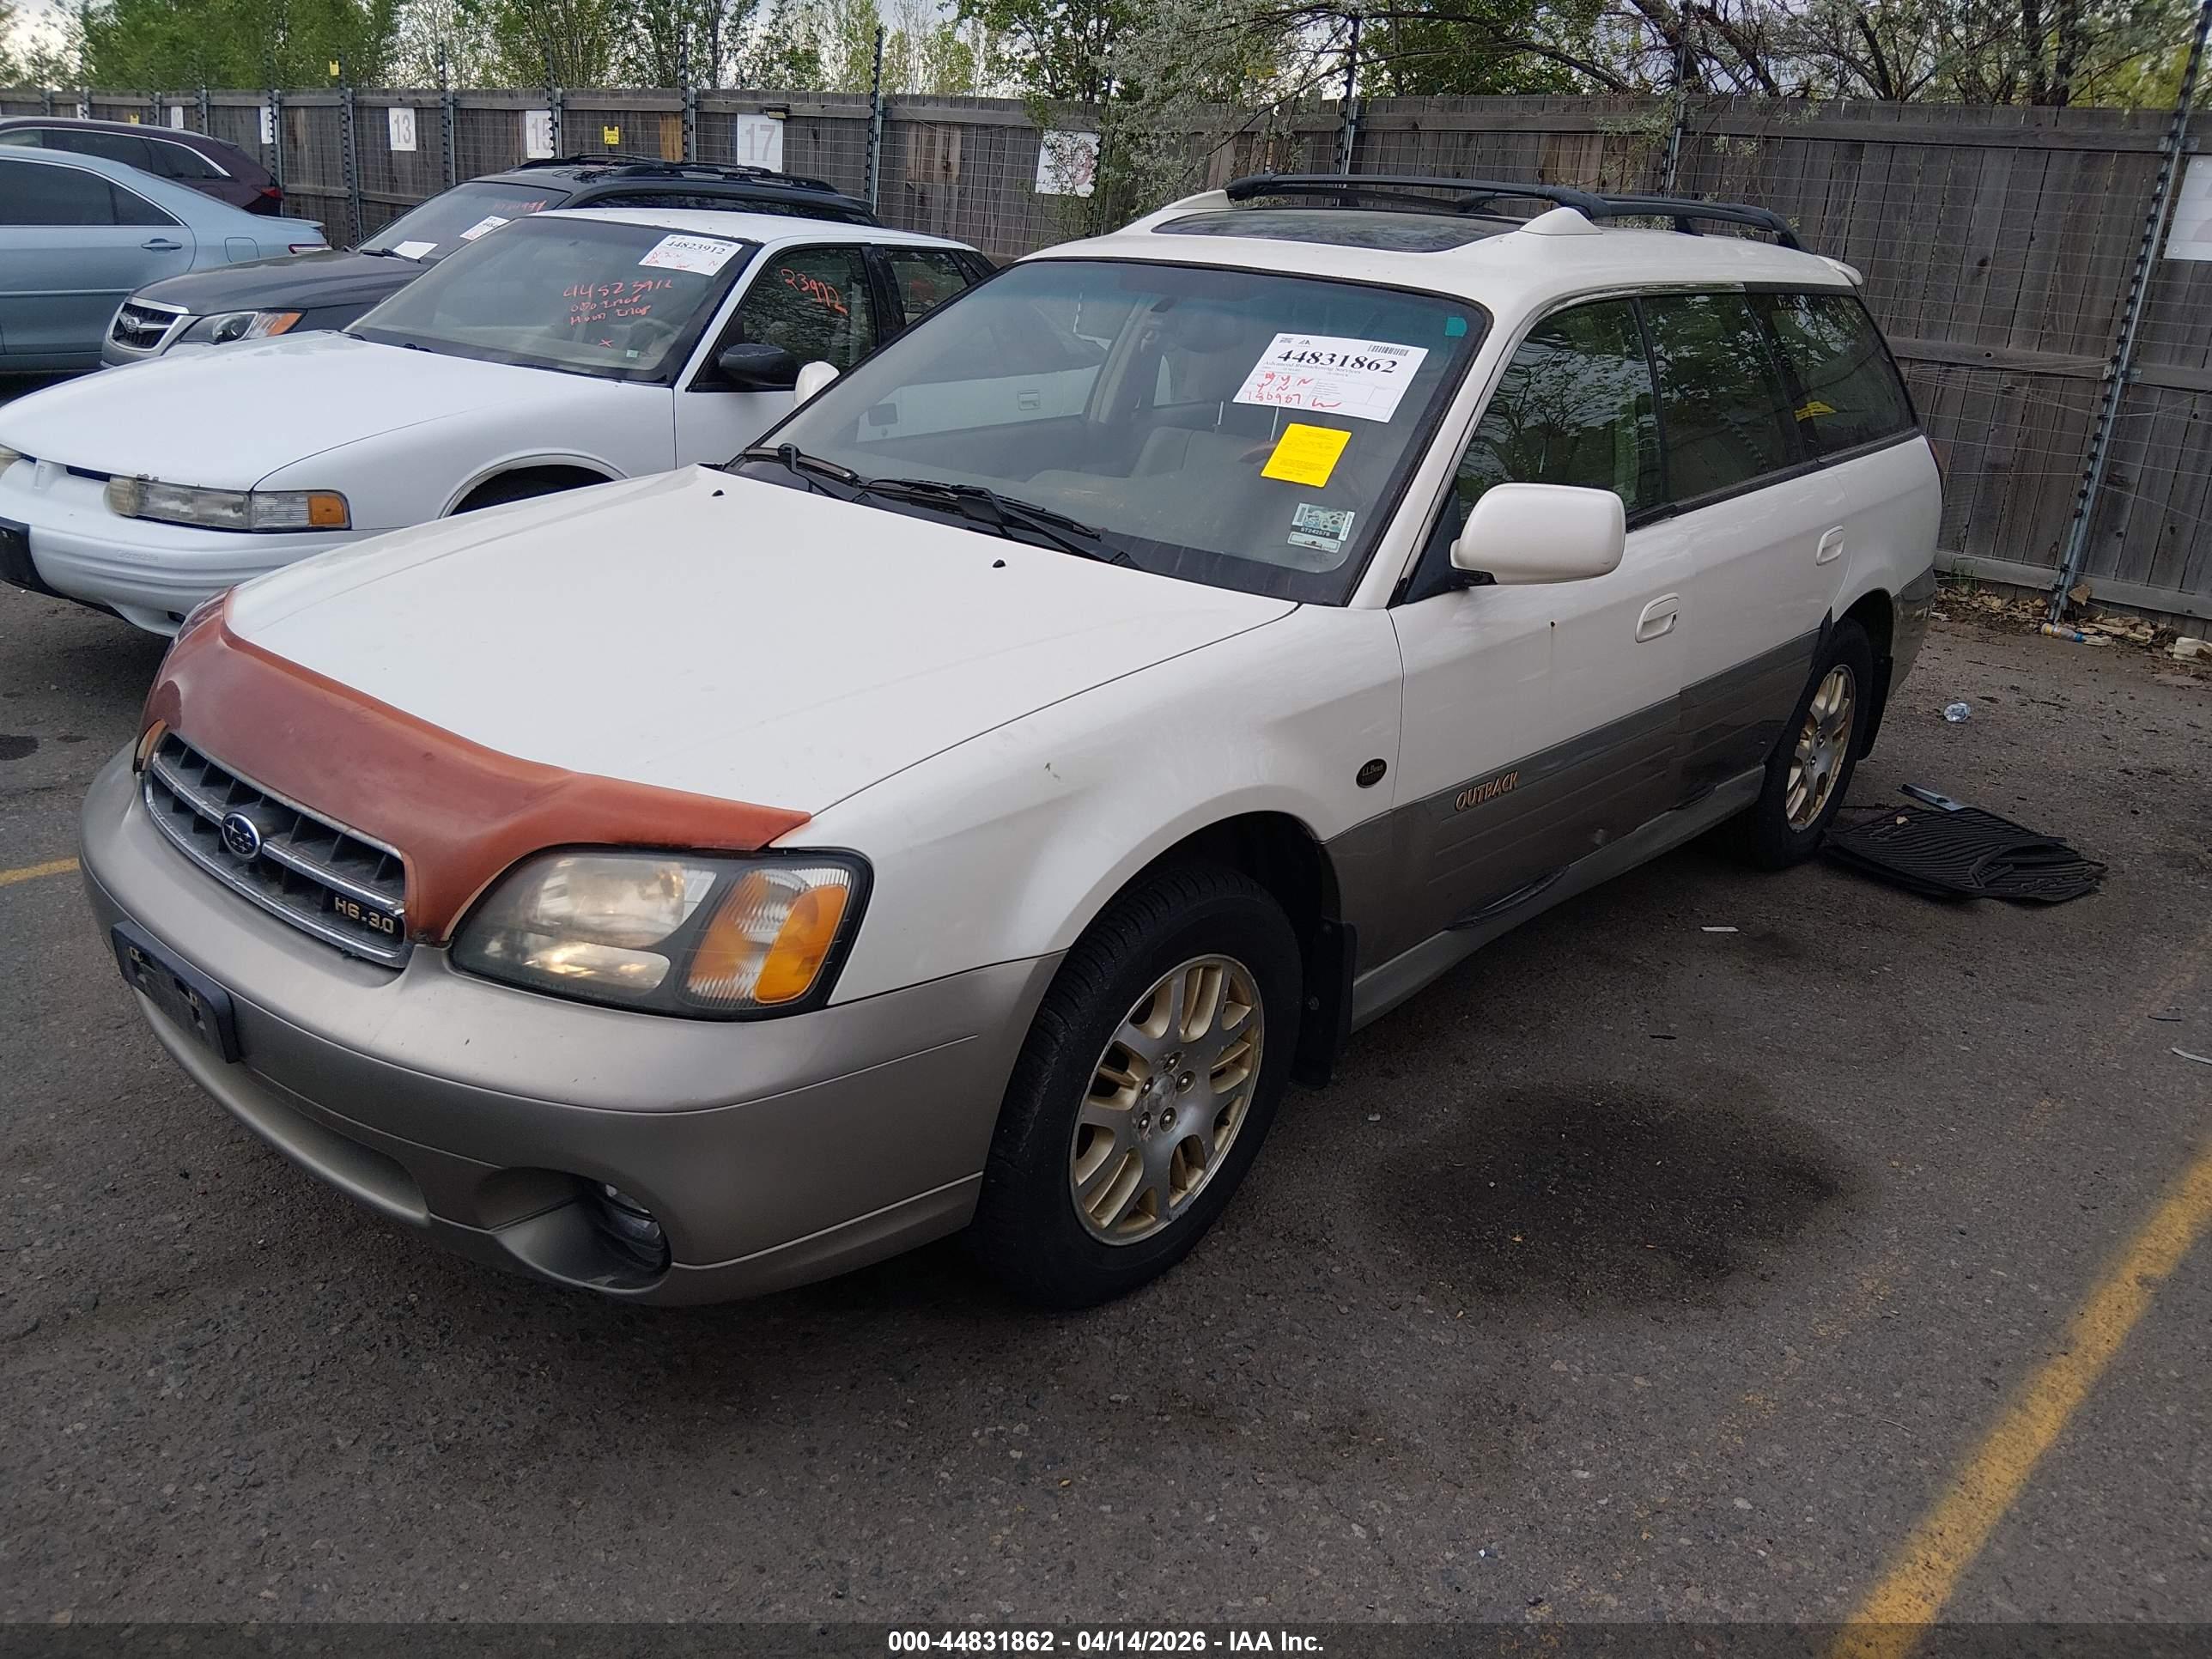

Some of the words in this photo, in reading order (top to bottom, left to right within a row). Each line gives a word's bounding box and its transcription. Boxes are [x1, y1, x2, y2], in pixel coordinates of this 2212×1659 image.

[394, 114, 411, 144] 13
[532, 118, 552, 151] 15
[745, 123, 776, 161] 17
[666, 240, 726, 255] 44823912
[1277, 349, 1398, 374] 44831862
[1455, 770, 1518, 811] OUTBACK
